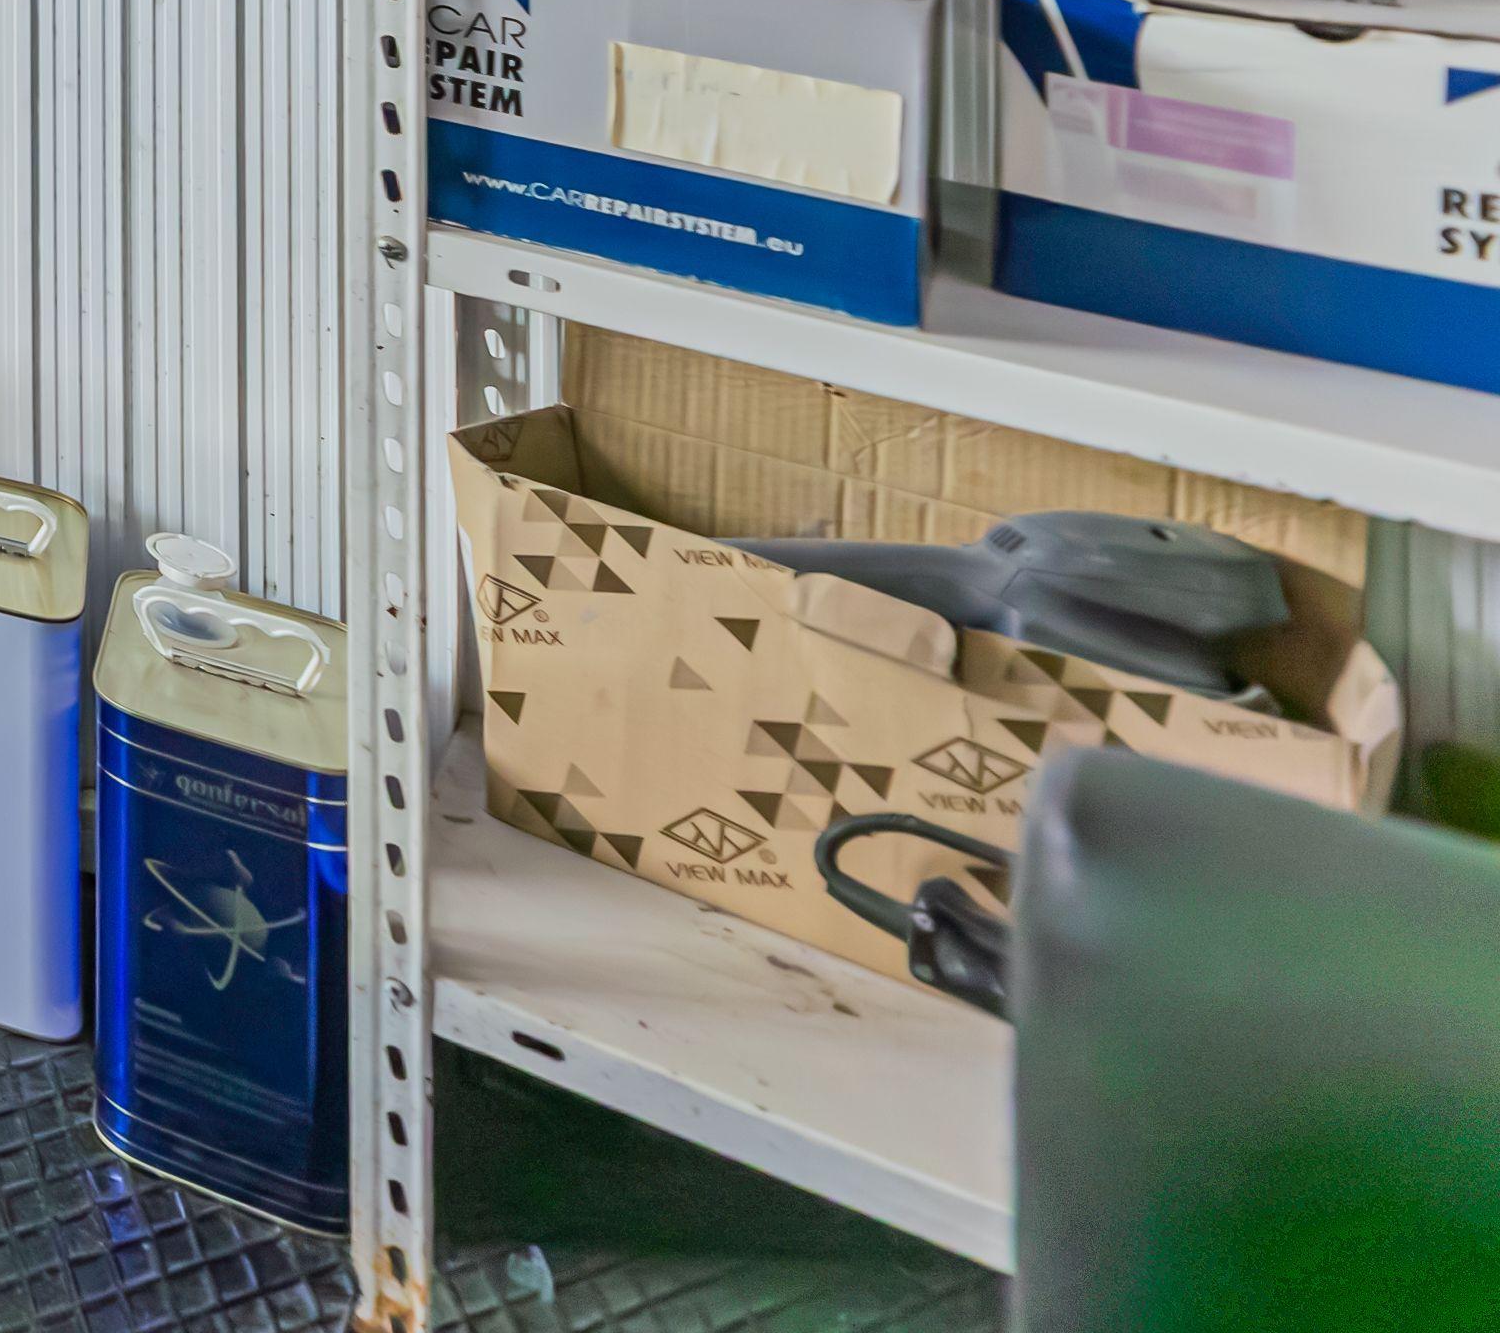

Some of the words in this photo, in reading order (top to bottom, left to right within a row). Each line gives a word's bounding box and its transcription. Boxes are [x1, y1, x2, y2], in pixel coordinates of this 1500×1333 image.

[428, 4, 527, 49] CAR
[426, 37, 524, 83] PAIR
[428, 73, 524, 118] STEM
[665, 861, 727, 885] VIEW
[733, 866, 796, 890] MAX
